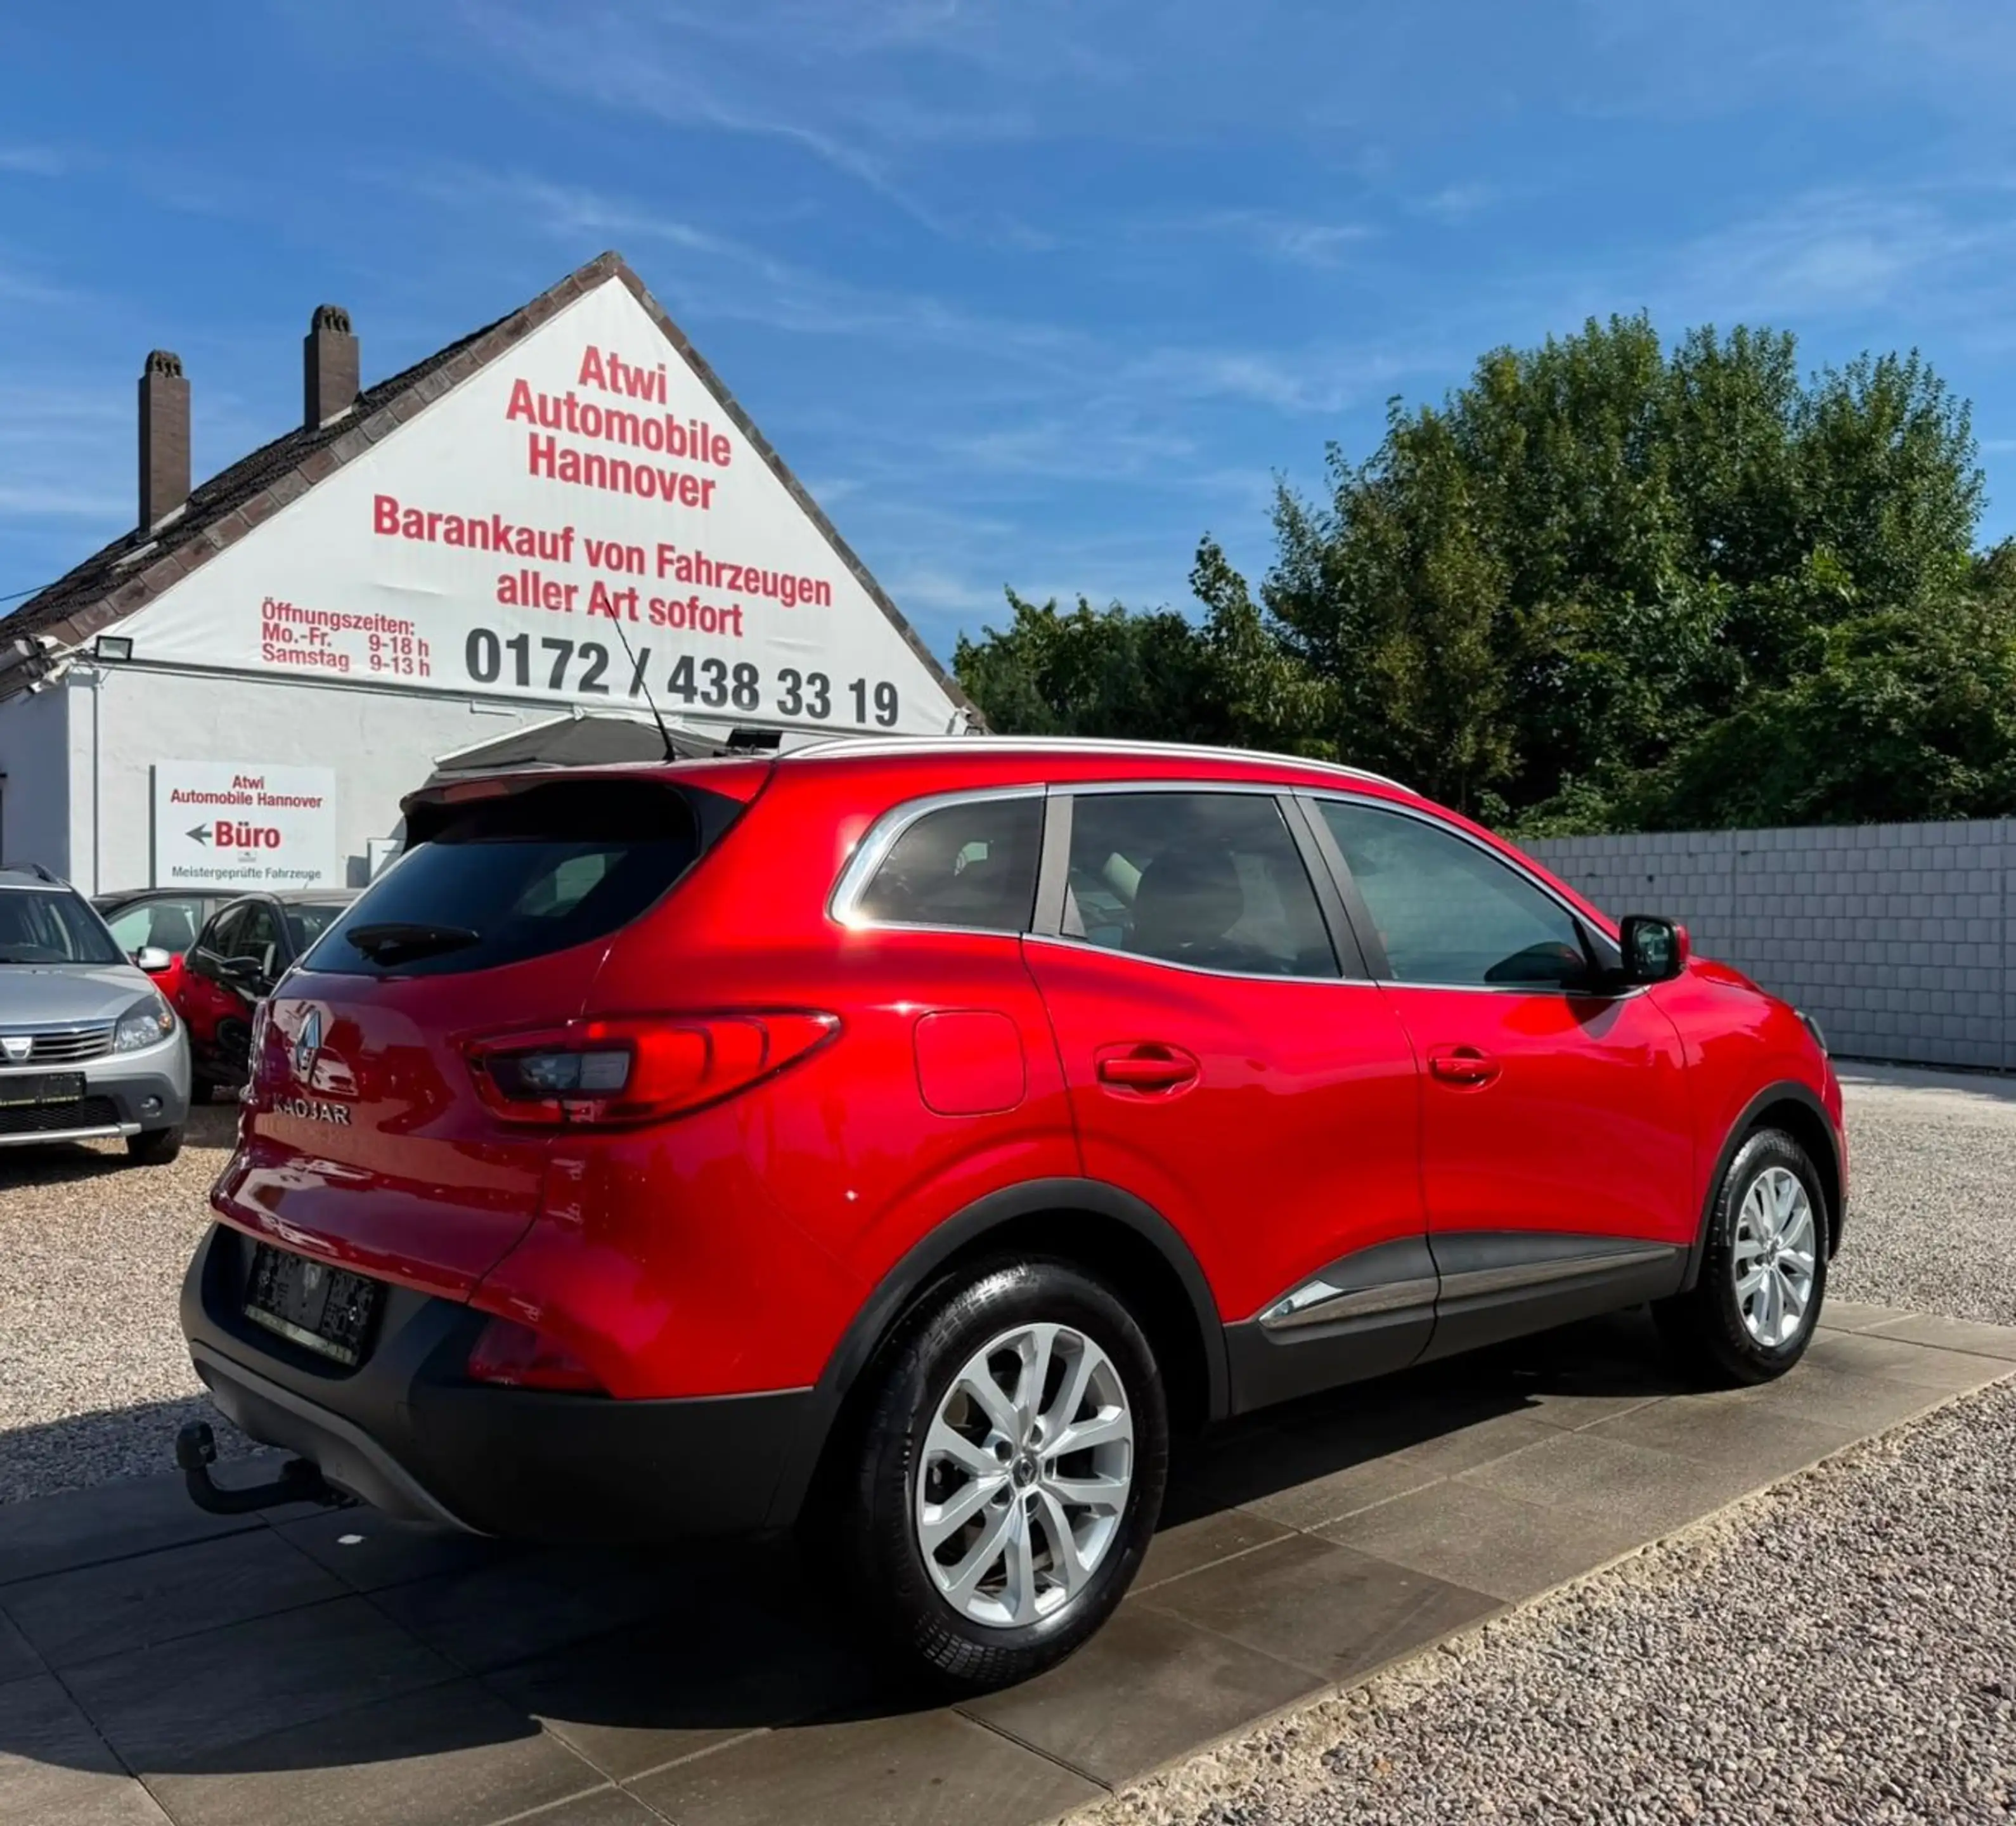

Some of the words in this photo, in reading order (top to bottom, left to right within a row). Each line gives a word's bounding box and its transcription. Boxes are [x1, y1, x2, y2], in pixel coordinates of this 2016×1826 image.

[578, 346, 668, 404] Atwi
[506, 379, 732, 467] Automobile
[528, 433, 716, 510] Hannover
[373, 495, 574, 563] Barankauf
[584, 539, 646, 575] von
[657, 543, 832, 608] Fahrzeugen
[261, 597, 415, 637] Öffnungszeiten:
[496, 571, 578, 612] aller
[587, 581, 639, 621] Art
[649, 595, 744, 637] sofort
[261, 622, 332, 647] Mo.-Fr.
[368, 635, 413, 657] 9-18
[417, 639, 429, 657] h
[261, 644, 350, 672] Samstag
[369, 654, 415, 676] 9-13
[418, 658, 430, 678] h
[465, 627, 610, 695] 0172
[629, 647, 652, 696] /
[667, 654, 760, 712] 438
[776, 668, 831, 720] 33
[848, 678, 899, 727] 19
[171, 789, 254, 806] Automobile
[256, 793, 324, 809] Hannover
[232, 775, 265, 790] Atwi
[215, 820, 281, 849] Büro
[171, 865, 263, 880] Meistergeprüfte
[264, 867, 322, 881] Fahrzeuge
[272, 1093, 351, 1126] KADJAR
